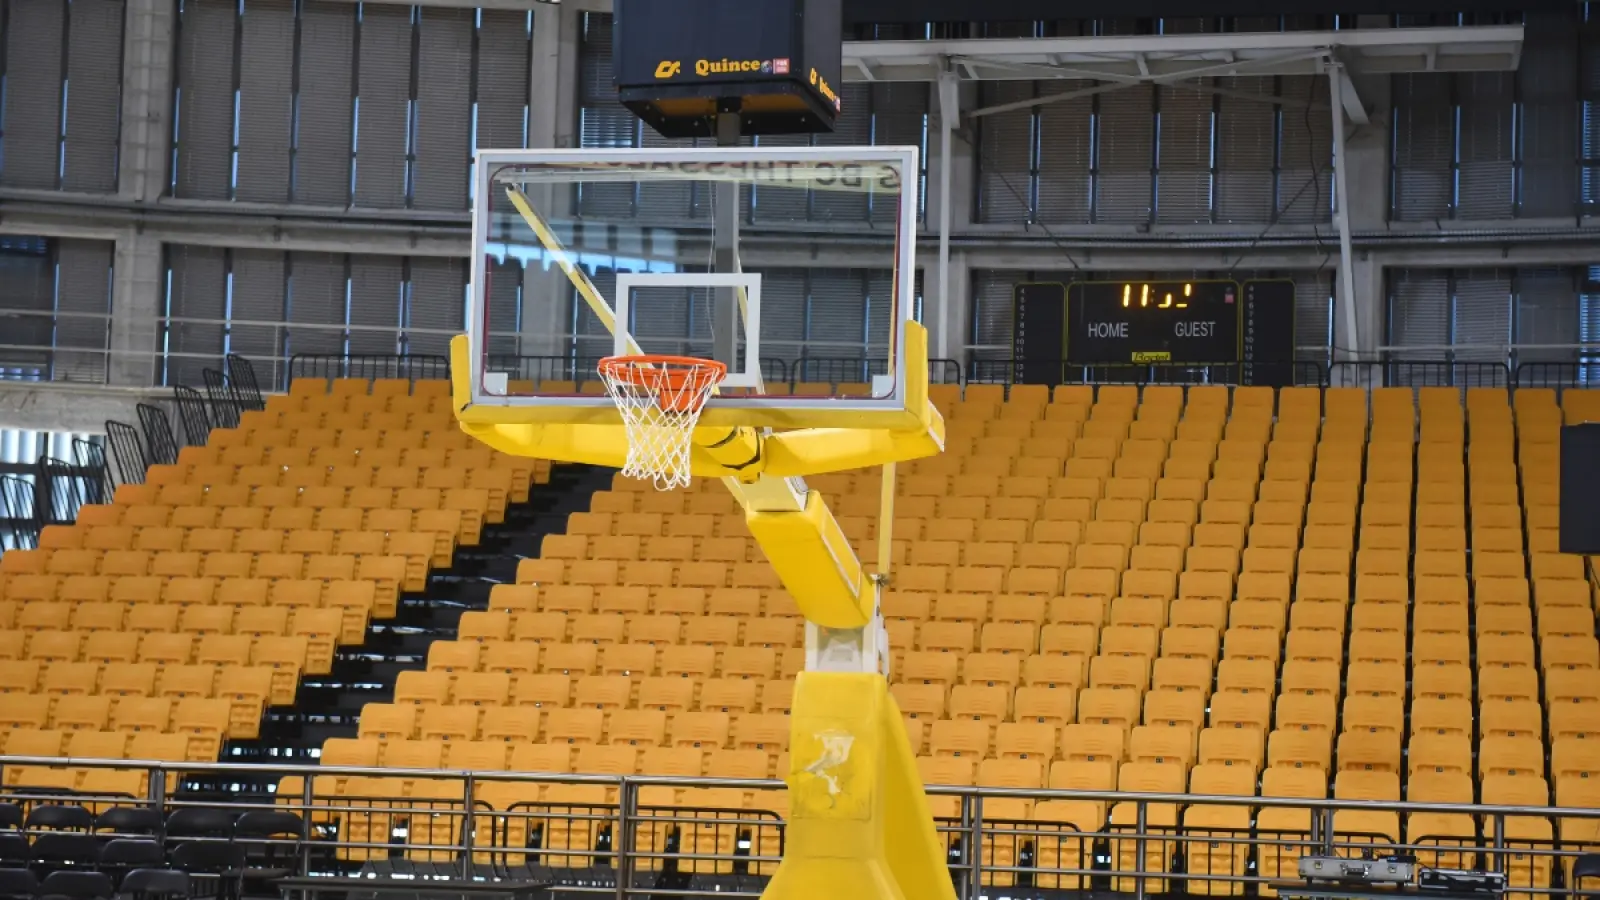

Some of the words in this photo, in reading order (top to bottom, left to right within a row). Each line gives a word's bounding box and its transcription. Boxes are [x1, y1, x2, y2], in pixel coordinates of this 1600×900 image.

[695, 58, 760, 77] Quince
[1087, 322, 1129, 338] HOME
[1174, 321, 1216, 337] GUEST
